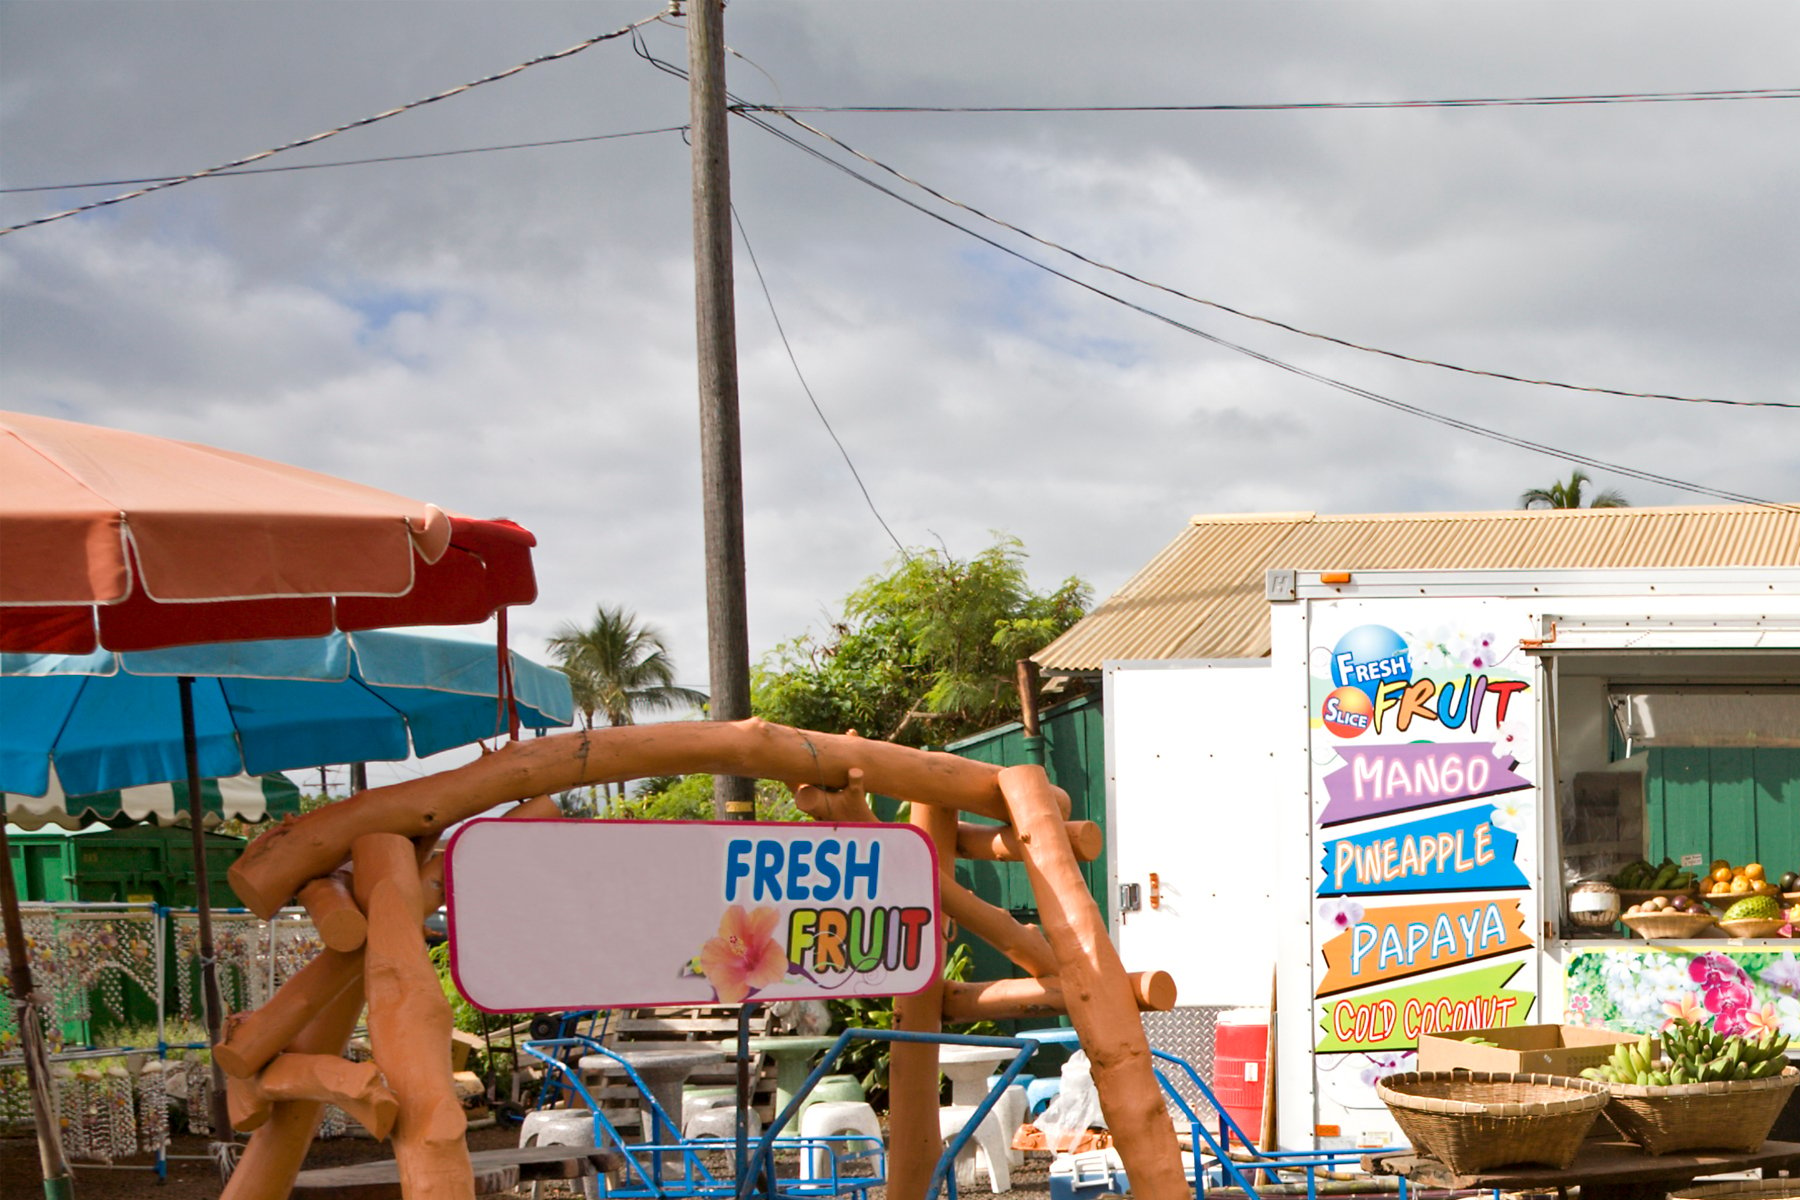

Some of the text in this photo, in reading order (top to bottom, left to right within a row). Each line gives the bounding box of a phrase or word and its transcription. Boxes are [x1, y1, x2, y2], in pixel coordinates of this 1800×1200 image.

[1335, 651, 1407, 686] FRESH
[1324, 696, 1368, 729] SLICE
[1373, 674, 1530, 735] FRUIT
[1352, 754, 1489, 801] MANGO
[725, 838, 881, 902] FRESH
[1334, 823, 1495, 889] PINEAPPLE
[787, 906, 933, 975] FRUIT
[1350, 904, 1507, 976] PAPAYA
[1333, 995, 1518, 1043] COLD COCONUT
